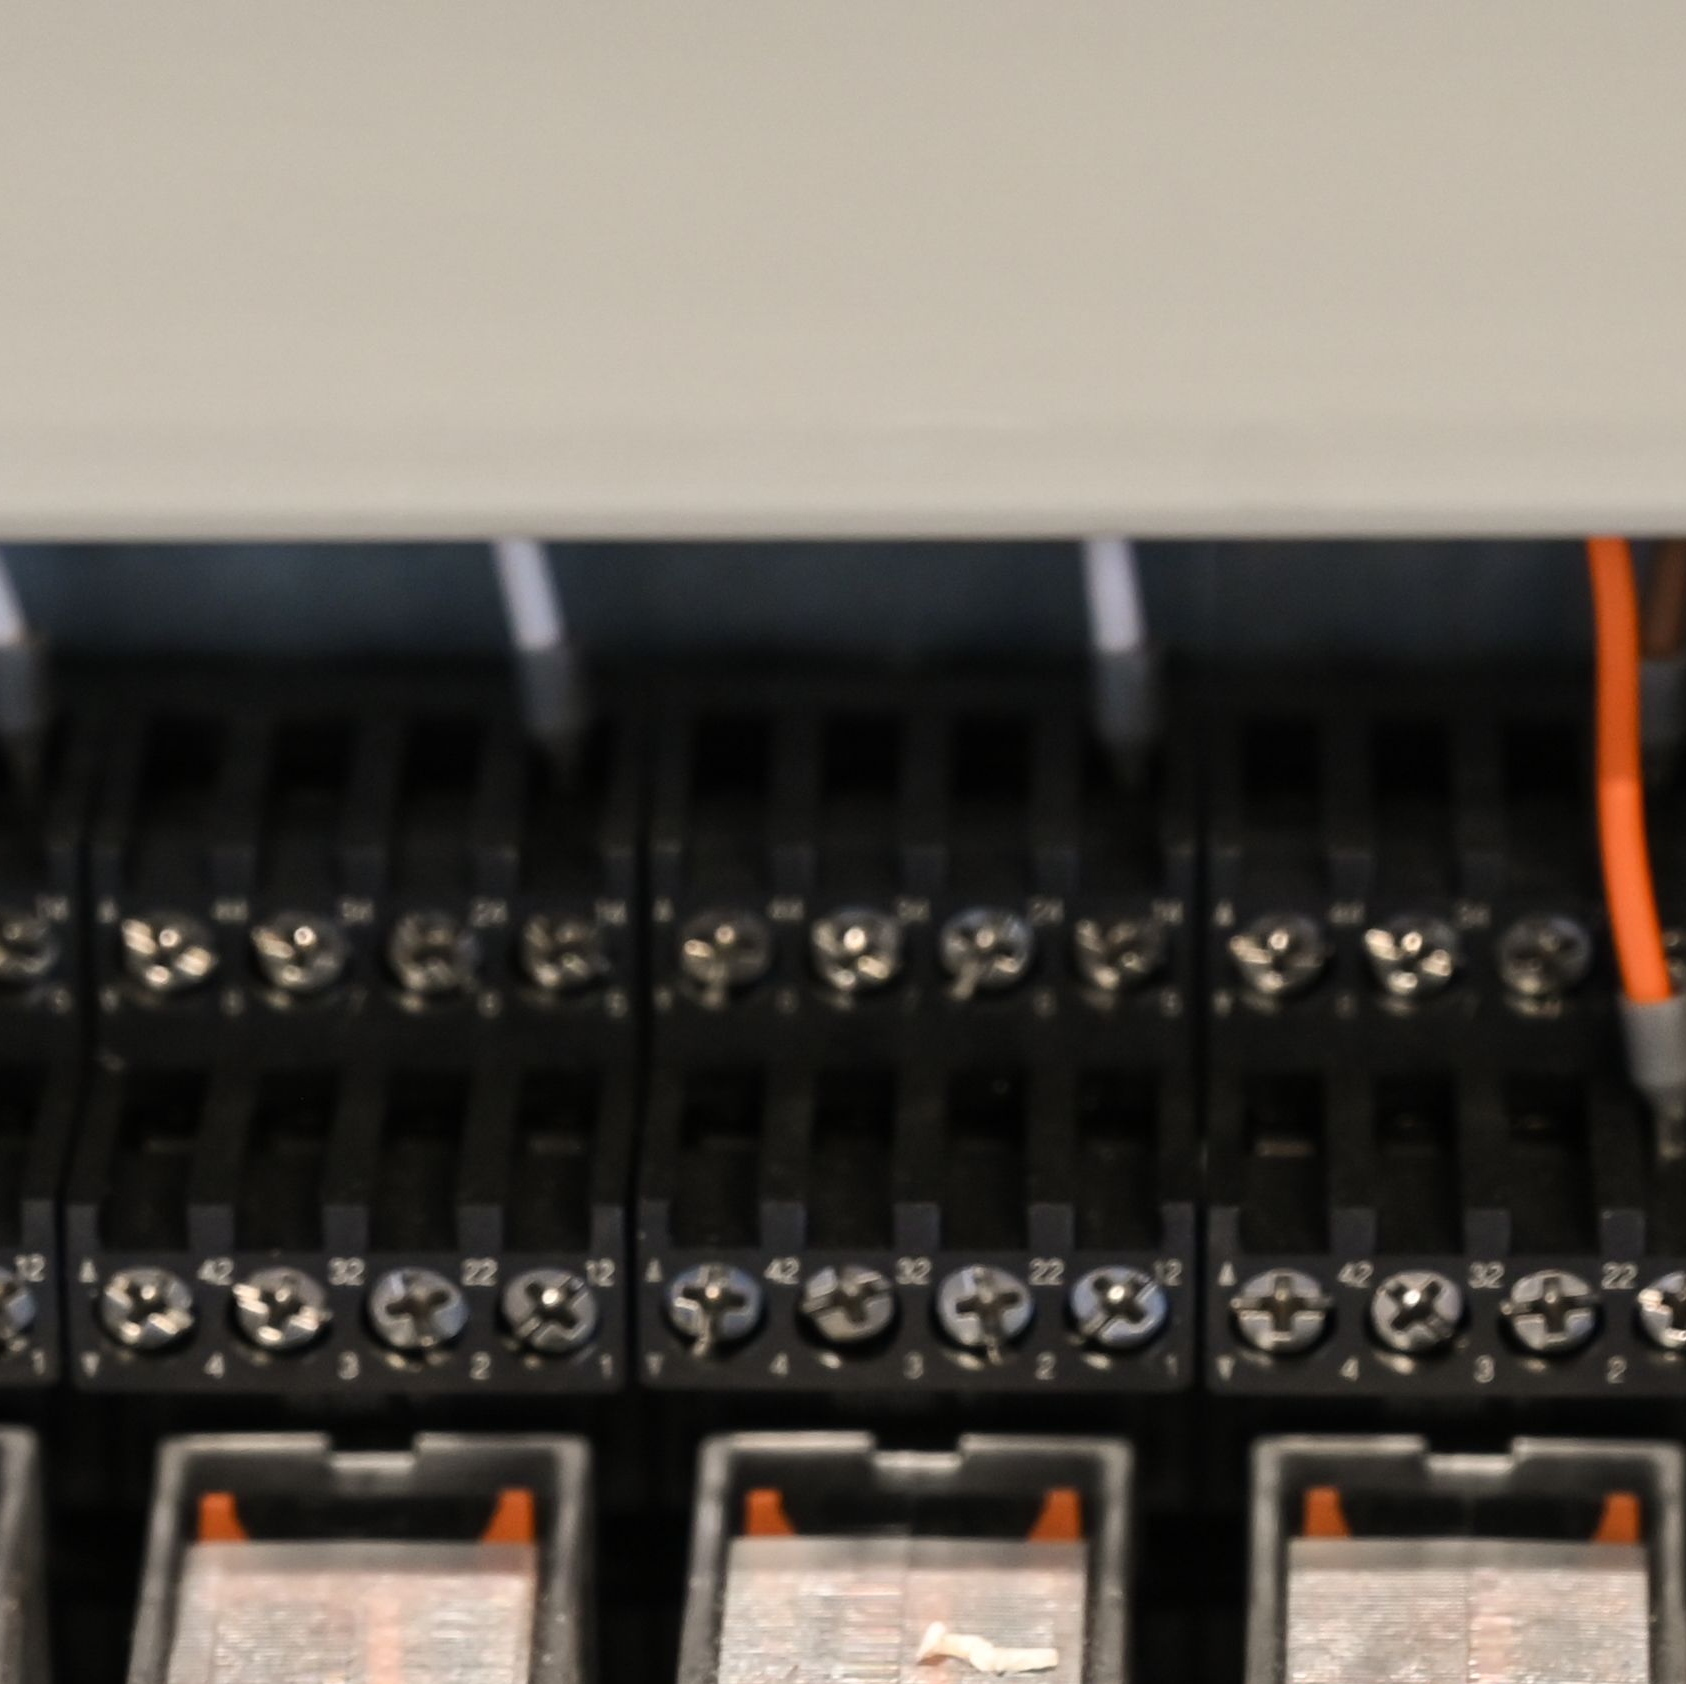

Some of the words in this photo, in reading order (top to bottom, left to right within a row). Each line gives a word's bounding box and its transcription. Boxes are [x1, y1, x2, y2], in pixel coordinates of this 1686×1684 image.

[16, 1254, 44, 1281] 12
[199, 1258, 233, 1285] 42
[331, 1258, 364, 1285] 32
[463, 1258, 497, 1286] 22
[587, 1259, 615, 1286] 12
[765, 1258, 799, 1284] 42
[897, 1258, 931, 1285] 32
[1030, 1259, 1063, 1285] 22
[1152, 1259, 1181, 1288] 12
[1338, 1261, 1373, 1288] 42
[1469, 1262, 1504, 1288] 32
[1602, 1263, 1636, 1289] 22
[1341, 1358, 1358, 1380] 4
[1476, 1356, 1493, 1383] 3
[1608, 1357, 1626, 1383] 2
